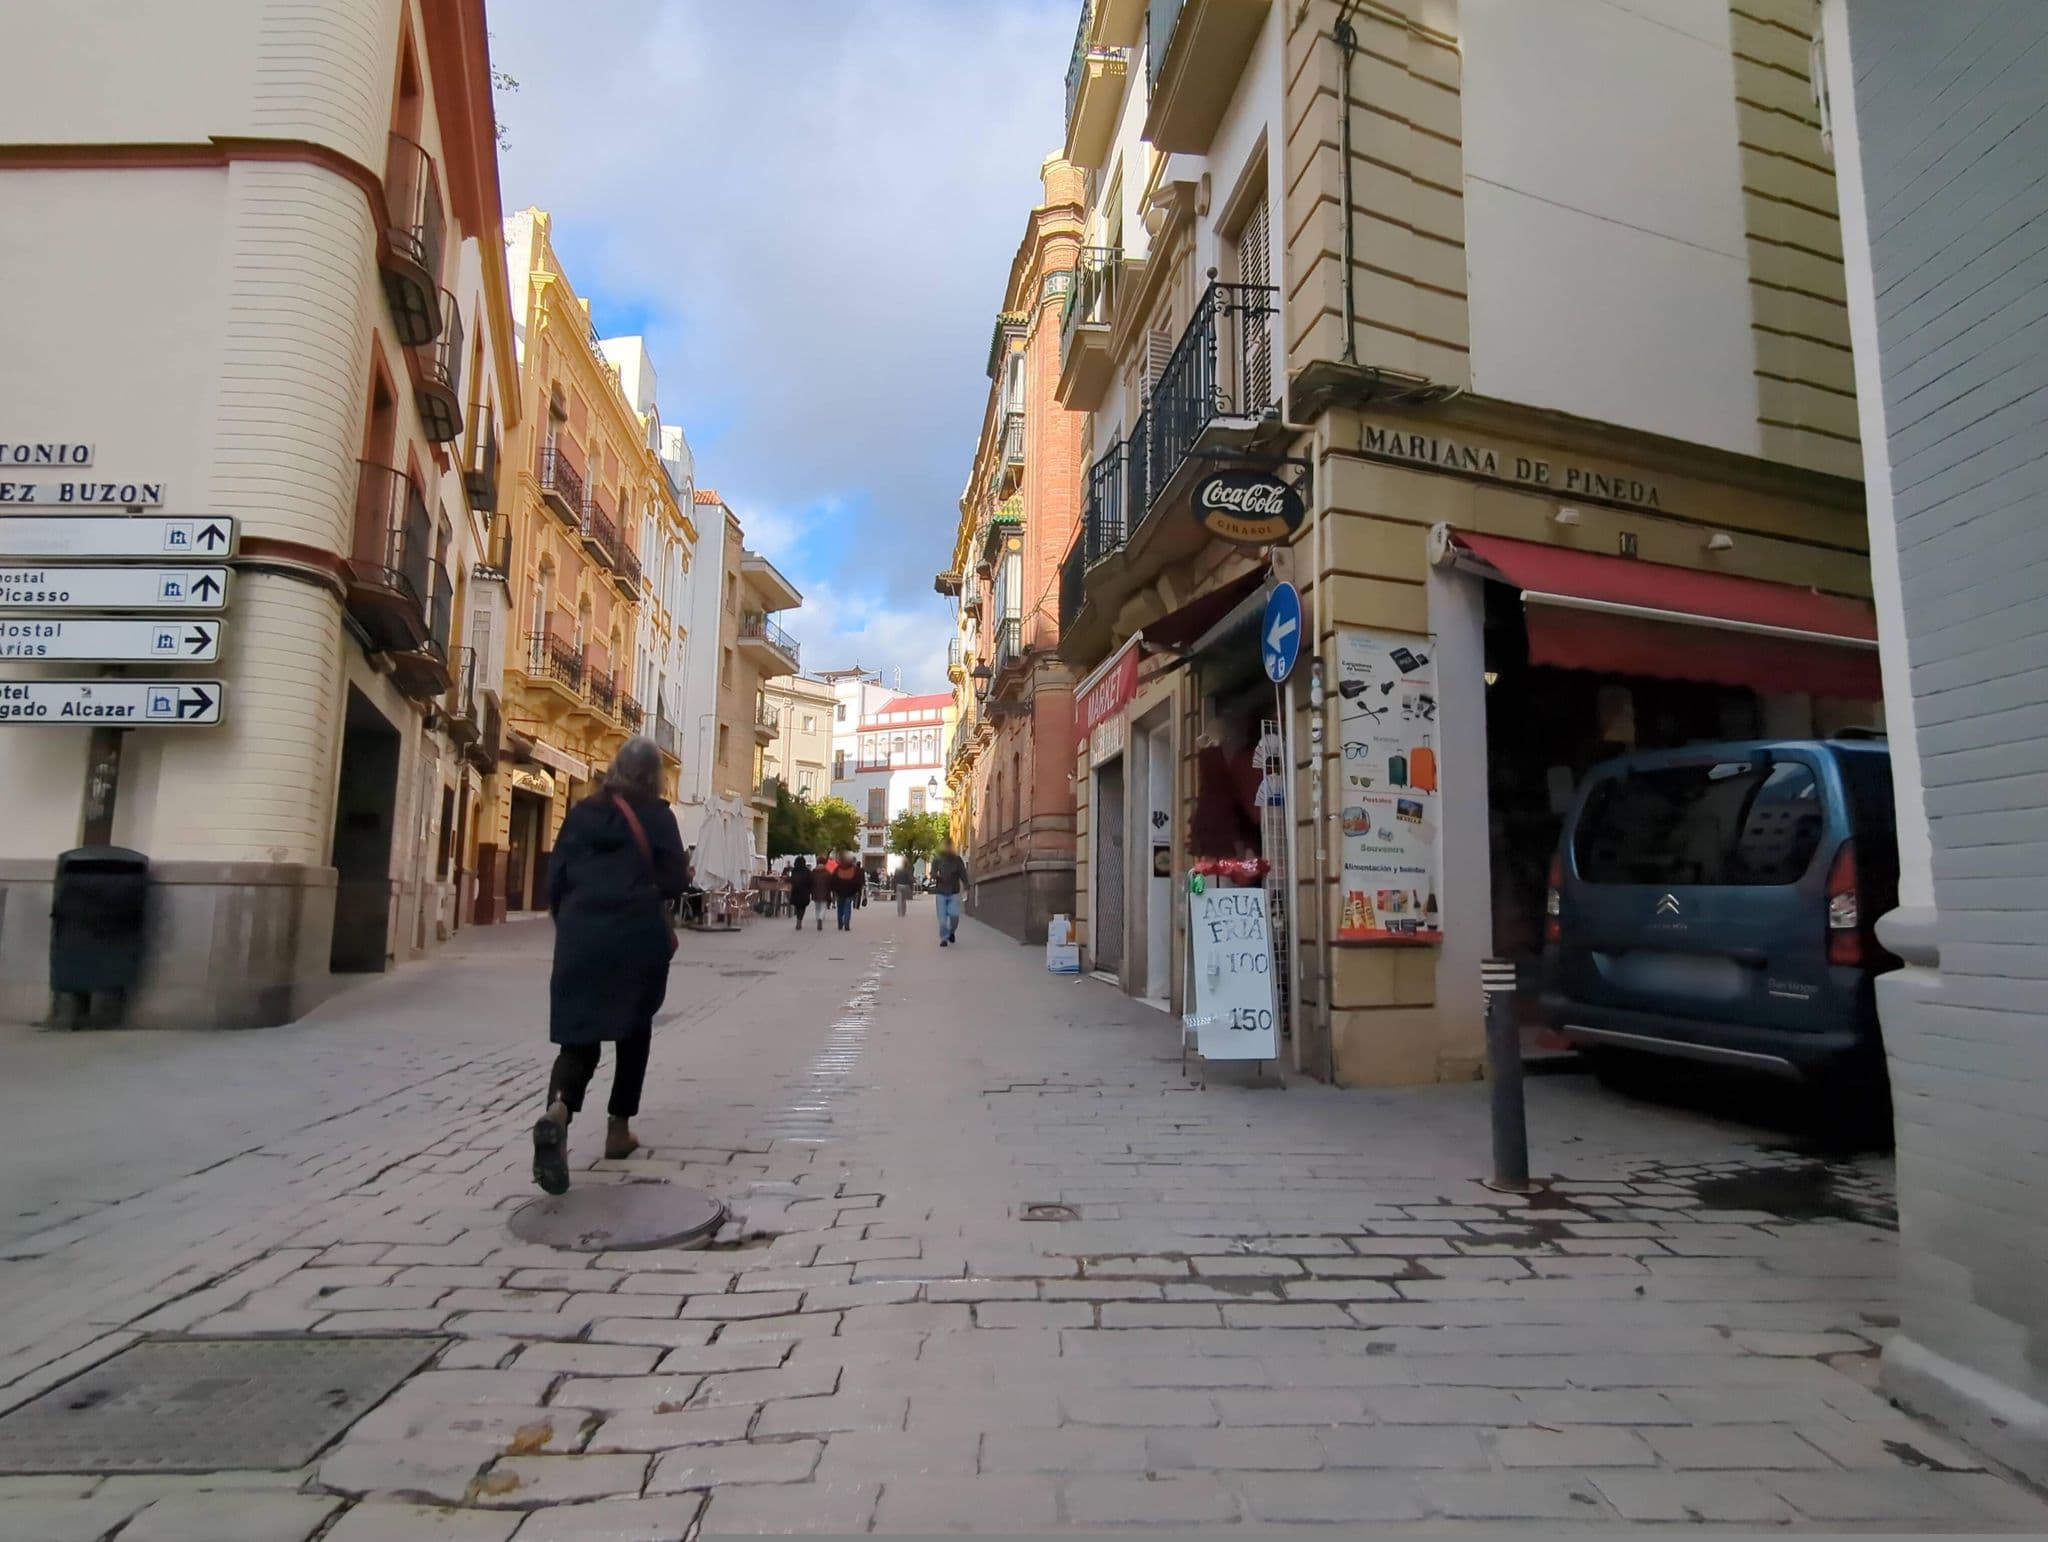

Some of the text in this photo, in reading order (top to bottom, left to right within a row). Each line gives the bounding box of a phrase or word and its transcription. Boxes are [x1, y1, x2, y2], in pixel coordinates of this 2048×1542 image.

[1364, 425, 1660, 506] MARIANA DE PINEDA
[0, 482, 161, 503] EZ BUZON
[0, 572, 44, 583] ostal
[0, 641, 47, 656] rias
[0, 685, 29, 700] tel
[1087, 664, 1123, 729] MARKET
[61, 702, 135, 717] Alcazar
[1203, 895, 1264, 919] AGUA
